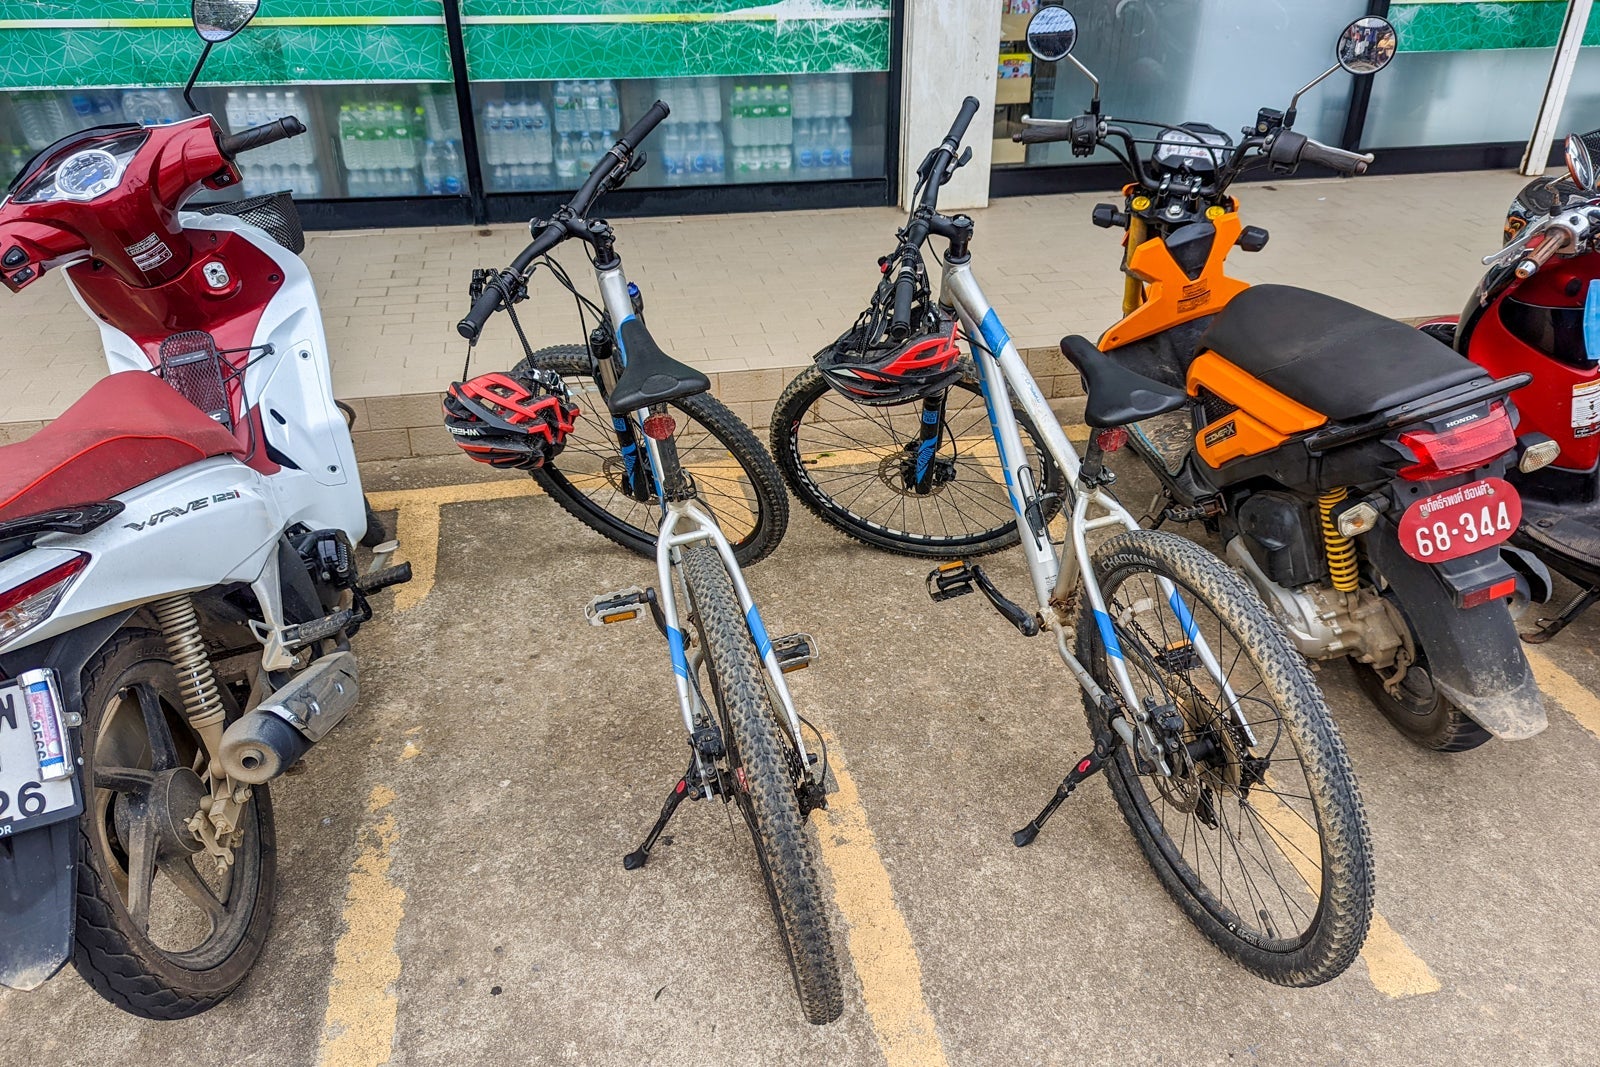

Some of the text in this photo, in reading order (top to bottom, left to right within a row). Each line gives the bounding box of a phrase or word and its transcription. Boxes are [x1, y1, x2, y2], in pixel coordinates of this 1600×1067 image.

[1446, 414, 1479, 428] HONDA
[121, 490, 241, 531] WAVE 125i
